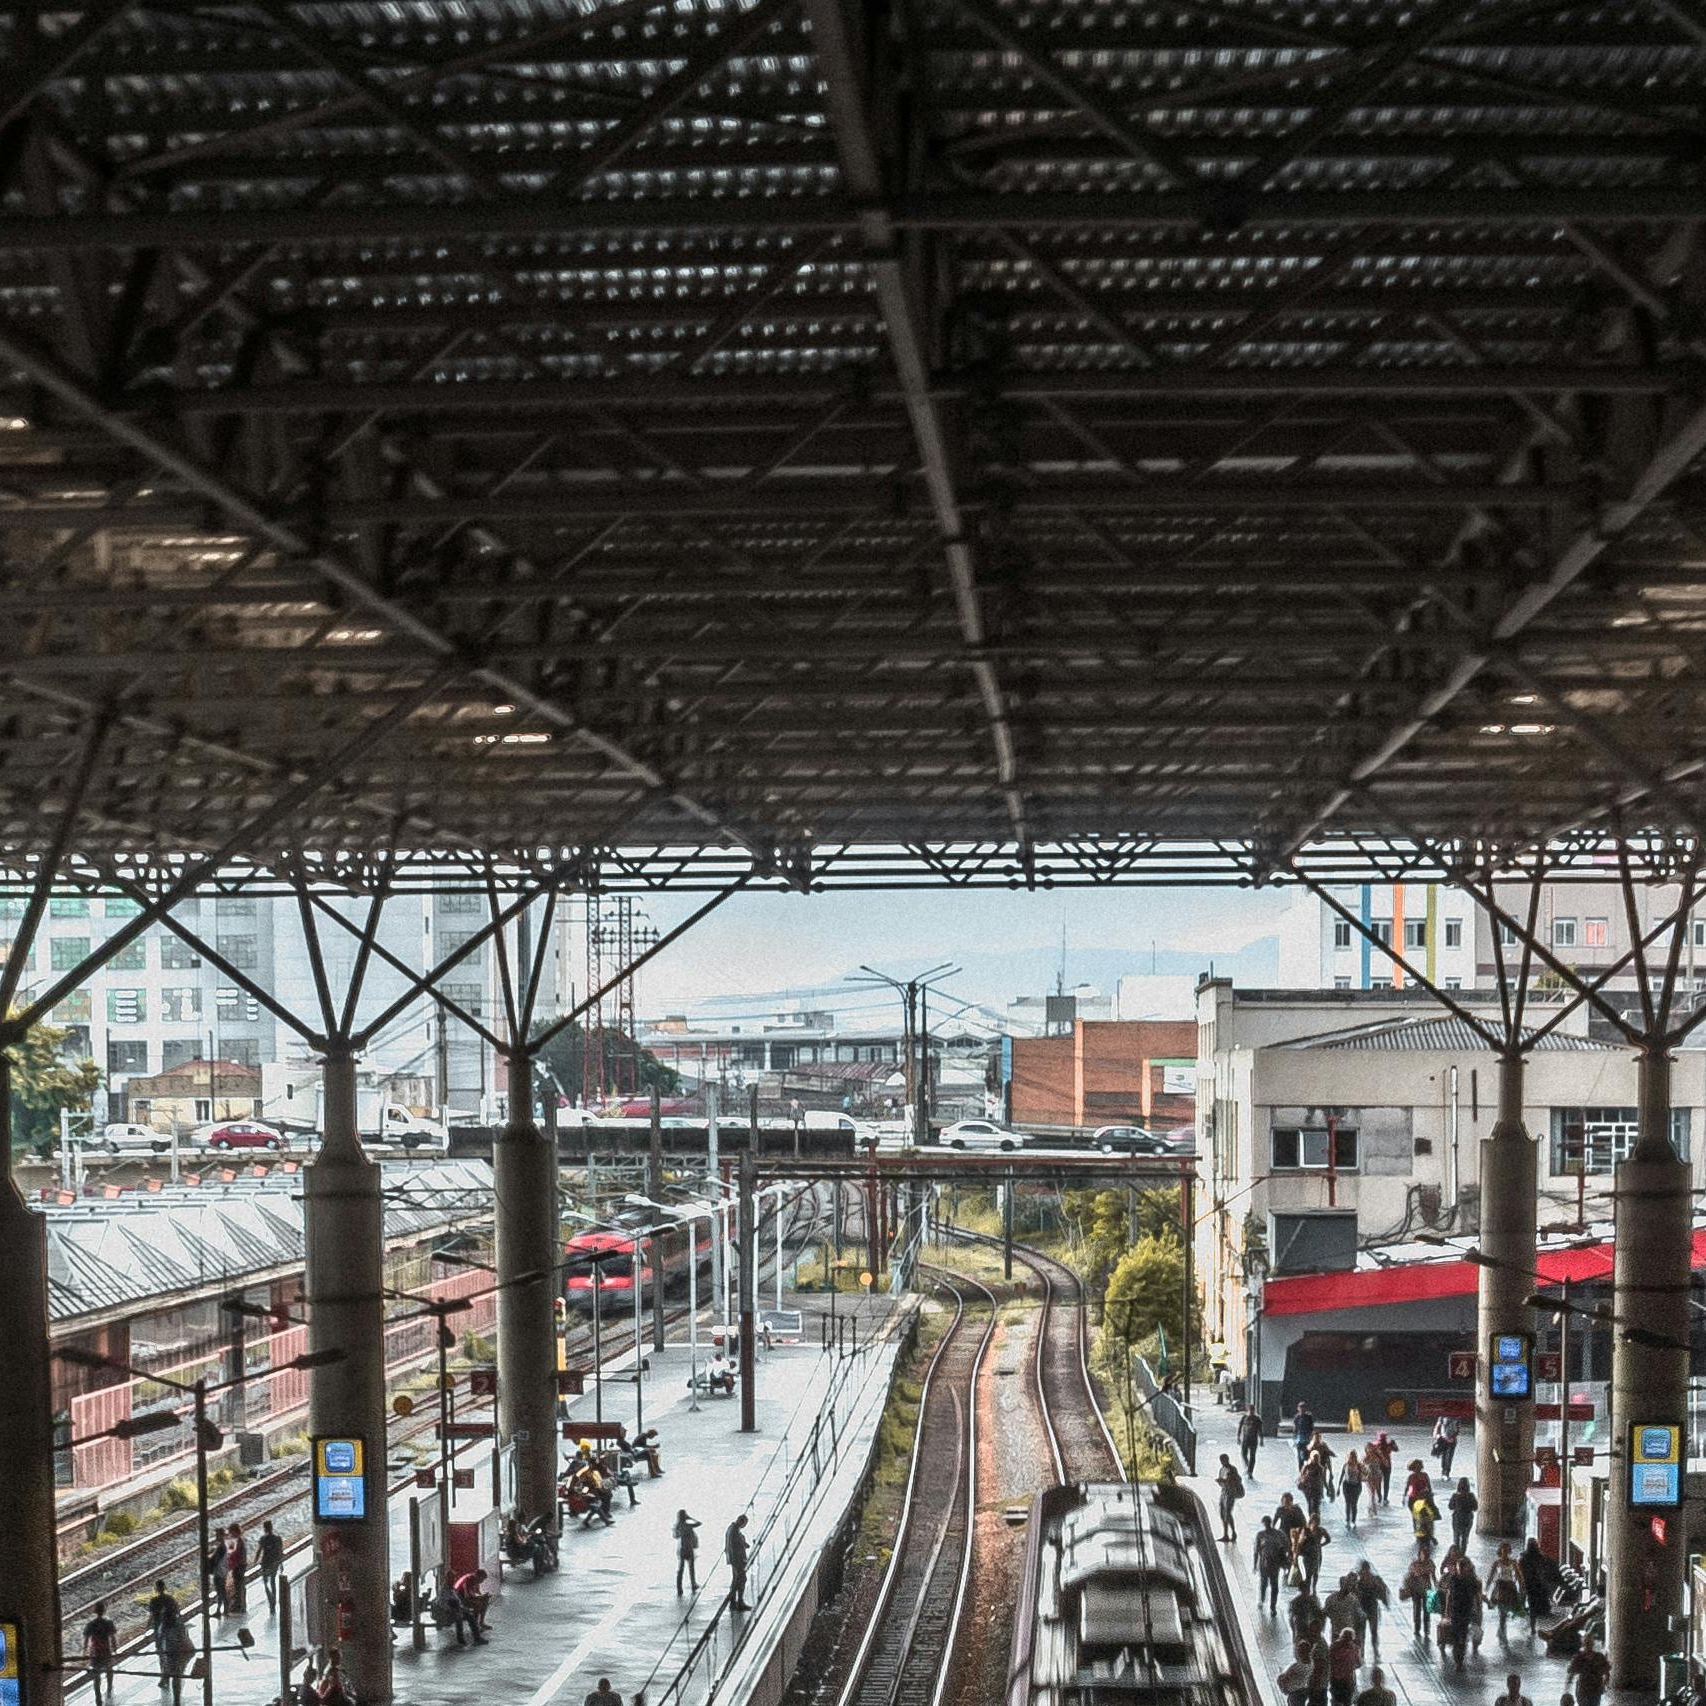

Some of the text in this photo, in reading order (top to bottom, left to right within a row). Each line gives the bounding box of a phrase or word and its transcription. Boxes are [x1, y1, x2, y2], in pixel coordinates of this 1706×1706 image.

[1454, 1360, 1470, 1376] 4
[1544, 1361, 1557, 1378] 5
[476, 1376, 490, 1394] 2
